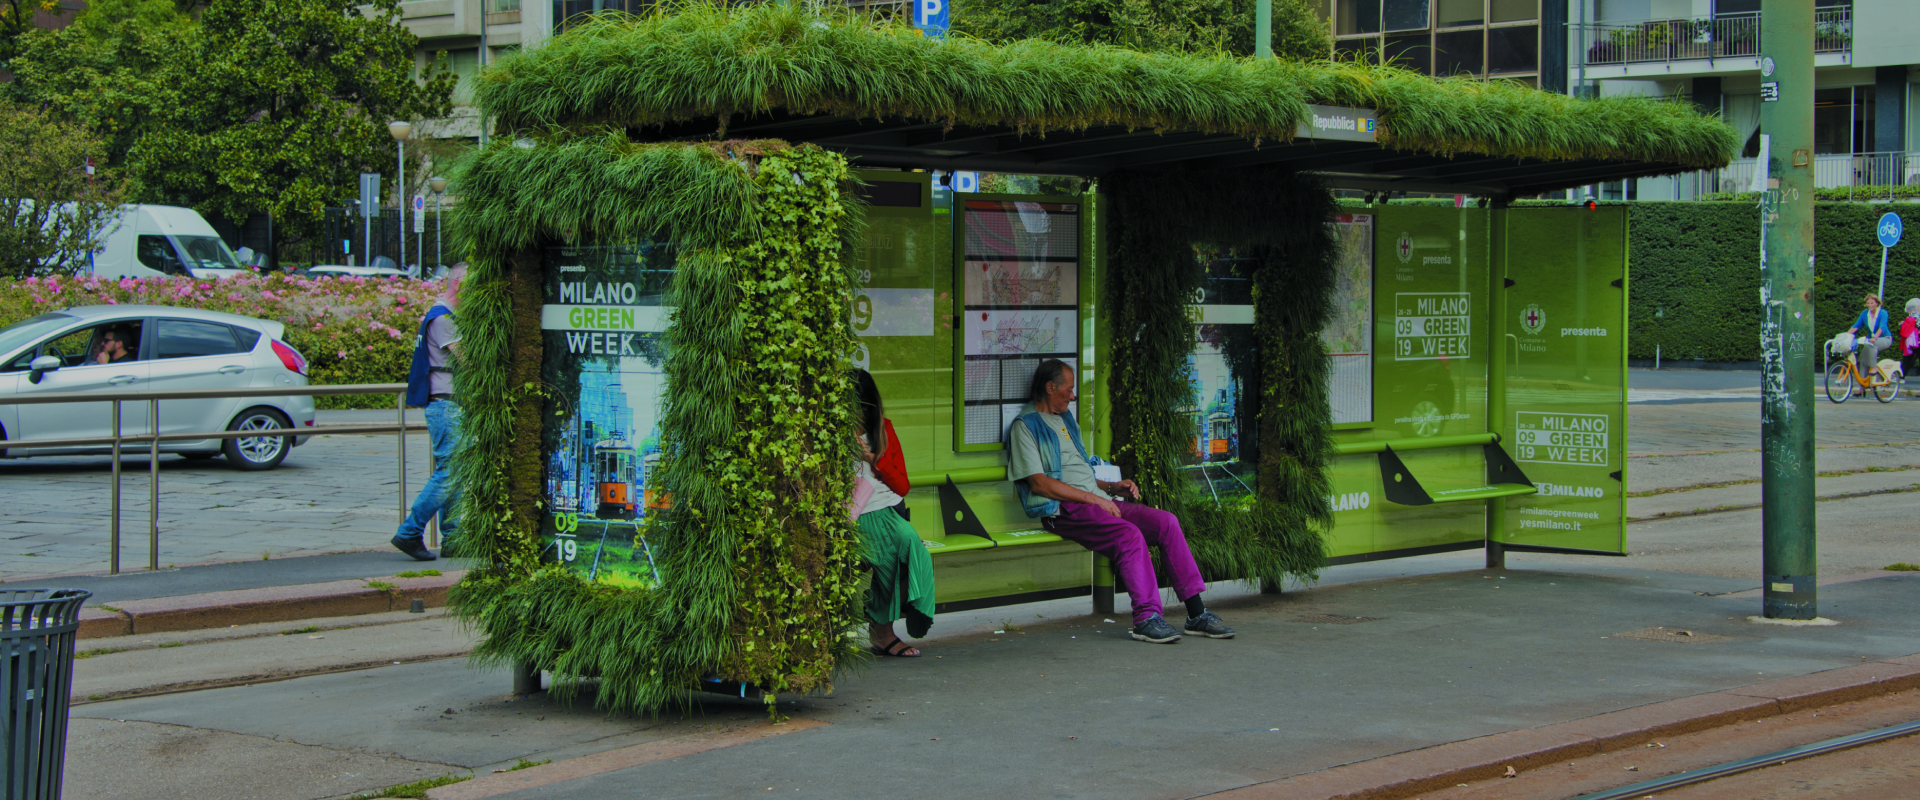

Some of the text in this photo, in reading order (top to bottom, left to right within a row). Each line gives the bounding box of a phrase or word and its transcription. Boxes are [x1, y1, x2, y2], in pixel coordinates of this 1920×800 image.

[921, 0, 942, 25] P
[1313, 114, 1355, 131] Repubblica
[1368, 121, 1374, 130] S
[1423, 255, 1452, 266] presenta
[560, 265, 586, 274] presenta
[1396, 273, 1414, 282] Milano
[560, 281, 637, 304] MILANO
[1417, 297, 1468, 315] MILANO
[569, 307, 635, 329] GREEN
[1397, 318, 1467, 335] 09 GREEN
[1561, 327, 1607, 337] presenta
[566, 331, 635, 355] WEEK
[1398, 337, 1467, 356] 19 WEEK
[1519, 343, 1547, 352] Milano
[1542, 416, 1605, 432] MILANO
[1519, 431, 1604, 447] 09 GREEN
[1519, 446, 1604, 463] 19 WEEK
[555, 511, 578, 532] 09
[1519, 507, 1599, 519] #milanogreenweek
[1520, 519, 1582, 531] yesmilano.it
[555, 538, 577, 562] 19
